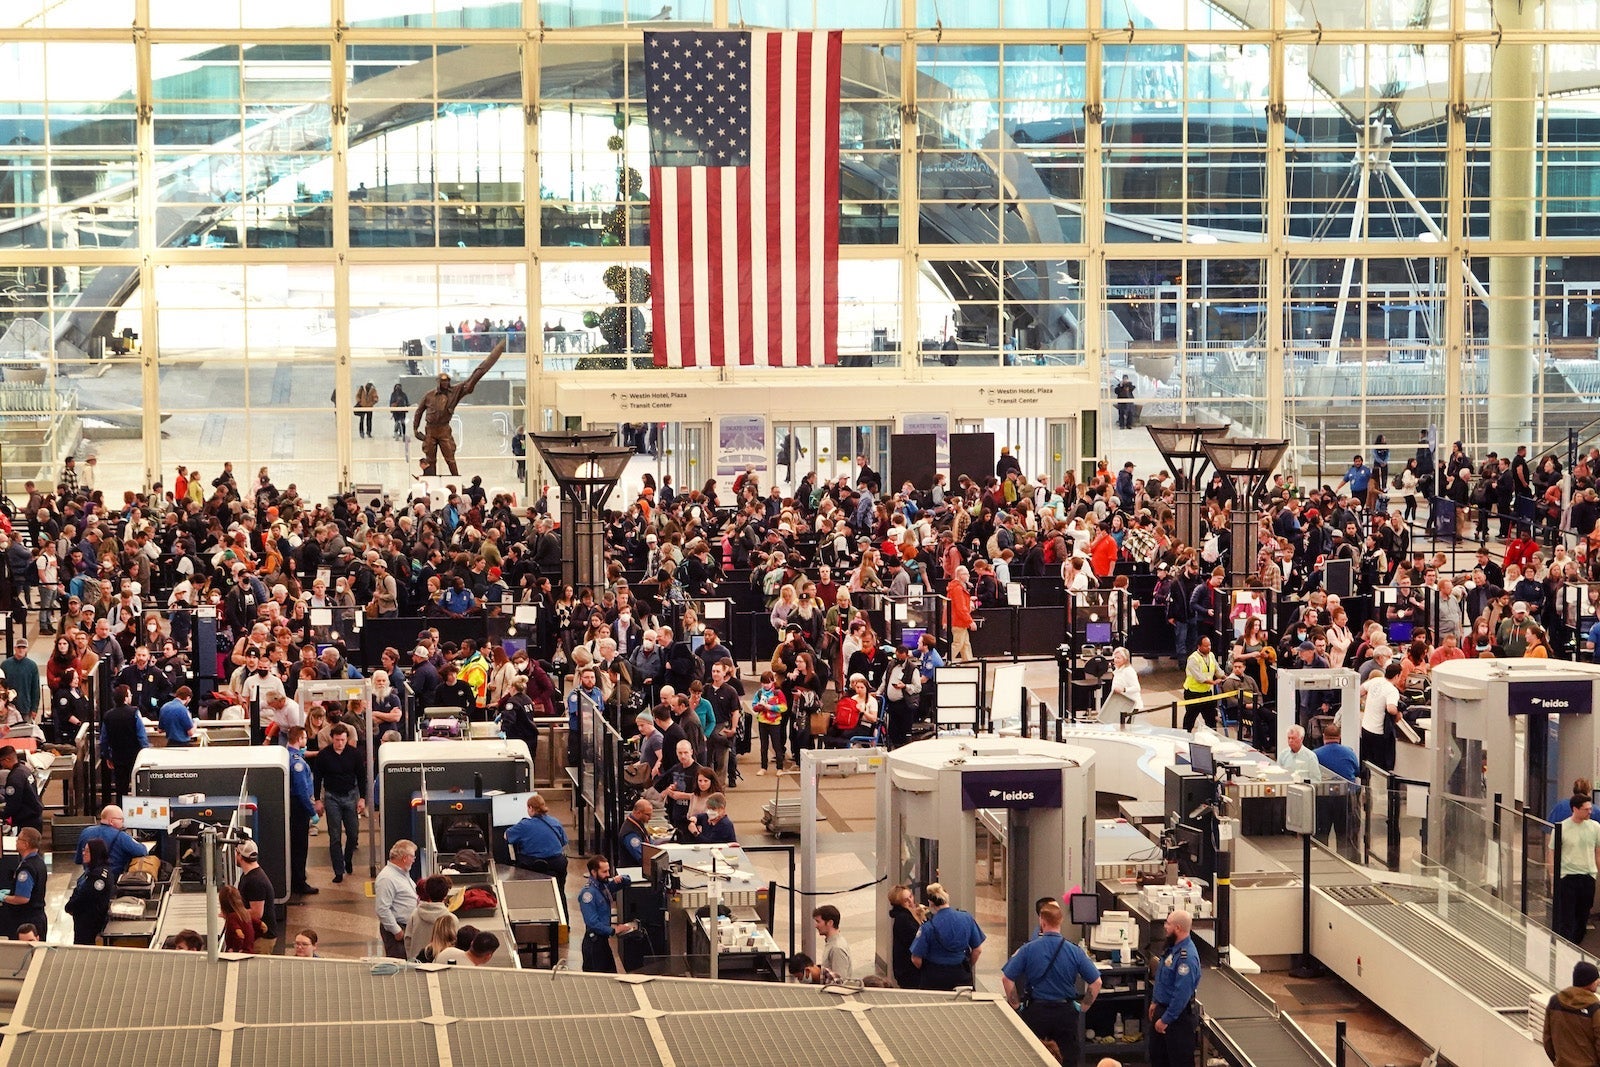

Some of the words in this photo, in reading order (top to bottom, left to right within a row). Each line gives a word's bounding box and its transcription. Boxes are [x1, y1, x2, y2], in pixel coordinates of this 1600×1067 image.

[652, 392, 669, 400] Hotel,
[1335, 677, 1348, 687] 10
[1542, 699, 1569, 708] leidos
[1003, 790, 1034, 801] leidos
